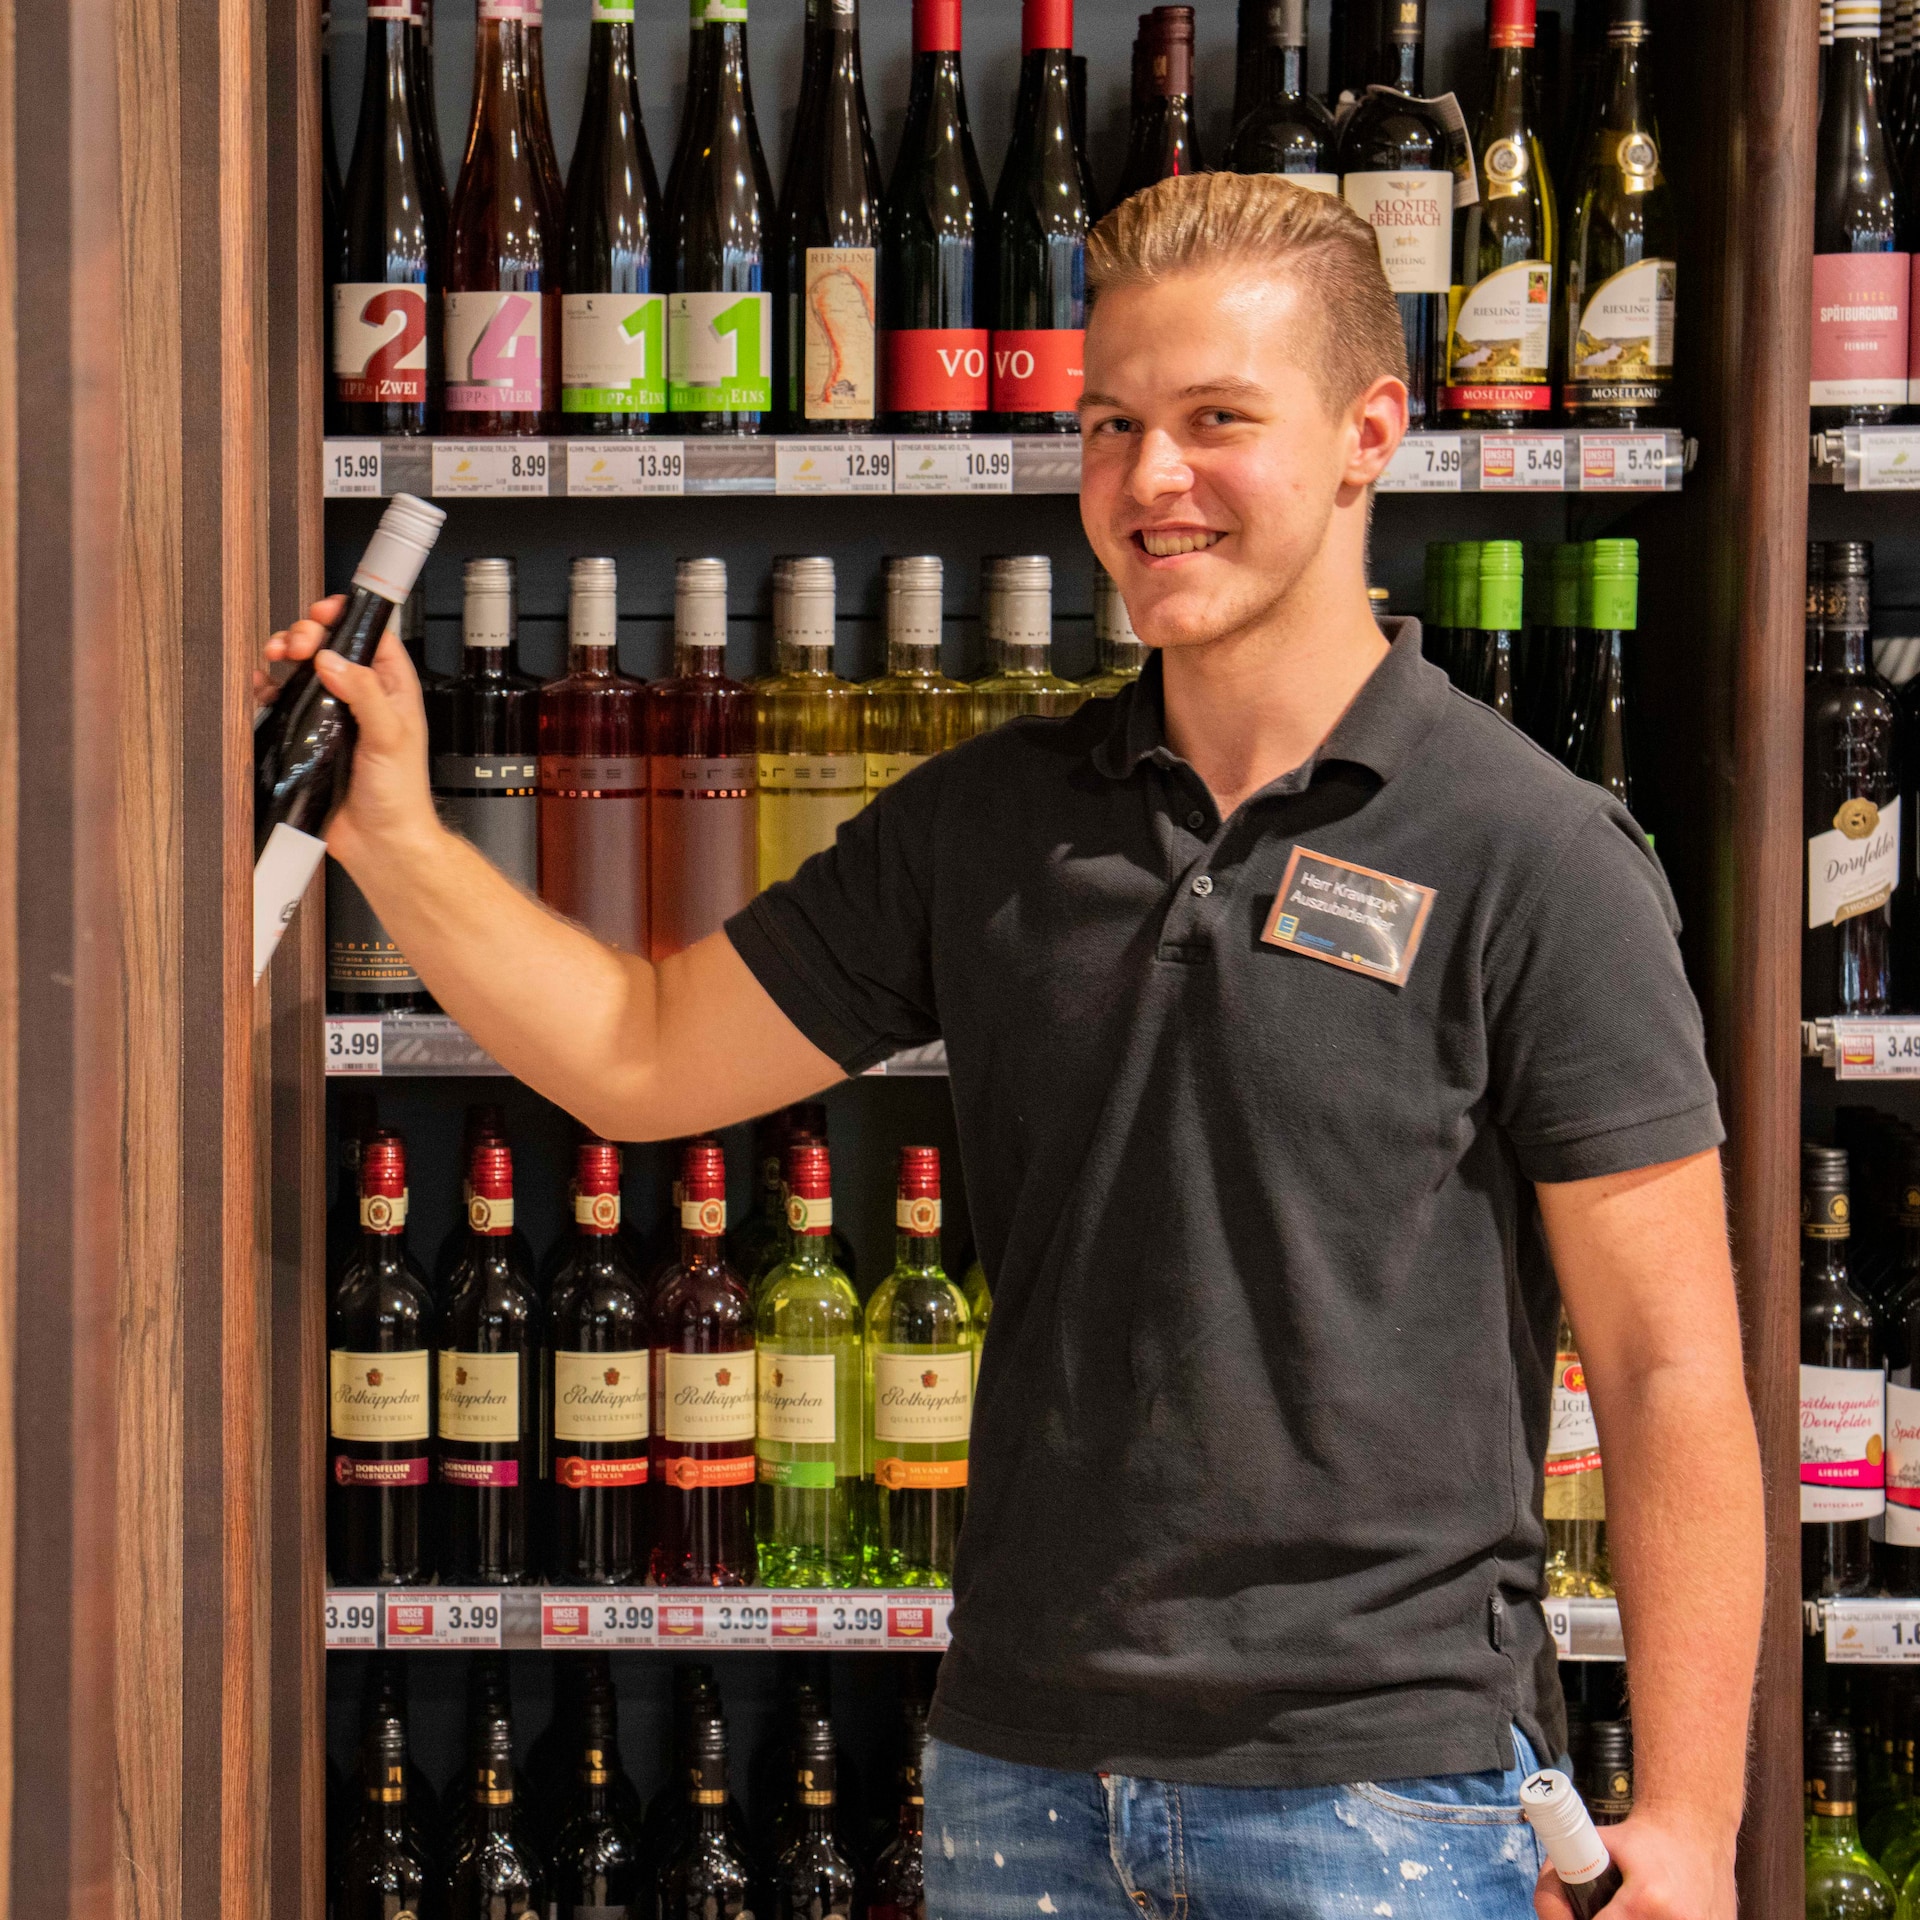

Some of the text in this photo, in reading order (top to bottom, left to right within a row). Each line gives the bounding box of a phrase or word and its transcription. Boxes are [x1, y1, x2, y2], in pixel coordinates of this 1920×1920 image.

[1375, 199, 1438, 213] KLOSTER
[1369, 213, 1441, 227] EBERBACH
[810, 252, 873, 264] RIESLING
[1386, 257, 1426, 266] RIESLING
[1473, 306, 1521, 317] RIESLING
[1602, 304, 1650, 315] RIESLING
[1820, 304, 1898, 322] SPÄTBURGUNDER
[361, 288, 426, 381] 2
[936, 348, 985, 378] VO
[994, 350, 1035, 379] VO
[380, 380, 418, 395] ZWEI
[499, 389, 532, 403] VIER
[731, 388, 765, 404] EINS
[1462, 389, 1533, 401] MOSELLAND
[1591, 387, 1661, 399] MOSELLAND
[846, 453, 890, 476] 12.99
[966, 453, 1010, 475] 10.99
[1425, 449, 1460, 472] 7.99
[1486, 449, 1513, 459] UNSER
[1528, 449, 1563, 470] 5.49
[1586, 449, 1613, 459] UNSER
[1628, 448, 1663, 470] 5.49
[334, 455, 379, 478] 15.99
[512, 455, 546, 477] 8.99
[638, 455, 682, 477] 13.99
[1824, 832, 1895, 883] Dornfelder
[1301, 871, 1333, 892] Herr
[1290, 889, 1395, 932] Auszubildender
[1844, 891, 1887, 914] TROCKEN
[334, 941, 395, 951] merlo
[355, 968, 409, 977] collection
[329, 1033, 379, 1055] 3.99
[334, 1384, 420, 1409] Rotkäppchen
[881, 1385, 968, 1411] Rotkäppchen
[1800, 1394, 1881, 1416] pätburgunder
[1801, 1410, 1873, 1434] Dornfelder
[1890, 1419, 1920, 1444] Spät
[356, 1464, 410, 1473] DORNFELDER
[910, 1466, 950, 1474] SILVANER
[1547, 1461, 1586, 1473] ALCOHOL
[1818, 1468, 1860, 1478] LIEBLICH
[325, 1606, 375, 1629] 3.99
[397, 1607, 425, 1618] UNSER
[449, 1606, 498, 1629] 3.99
[552, 1607, 580, 1618] UNSER
[604, 1606, 654, 1629] 3.99
[667, 1608, 694, 1618] UNSER
[719, 1607, 769, 1630] 3.99
[781, 1608, 808, 1619] UNSER
[833, 1608, 883, 1630] 3.99
[896, 1609, 923, 1620] UNSER
